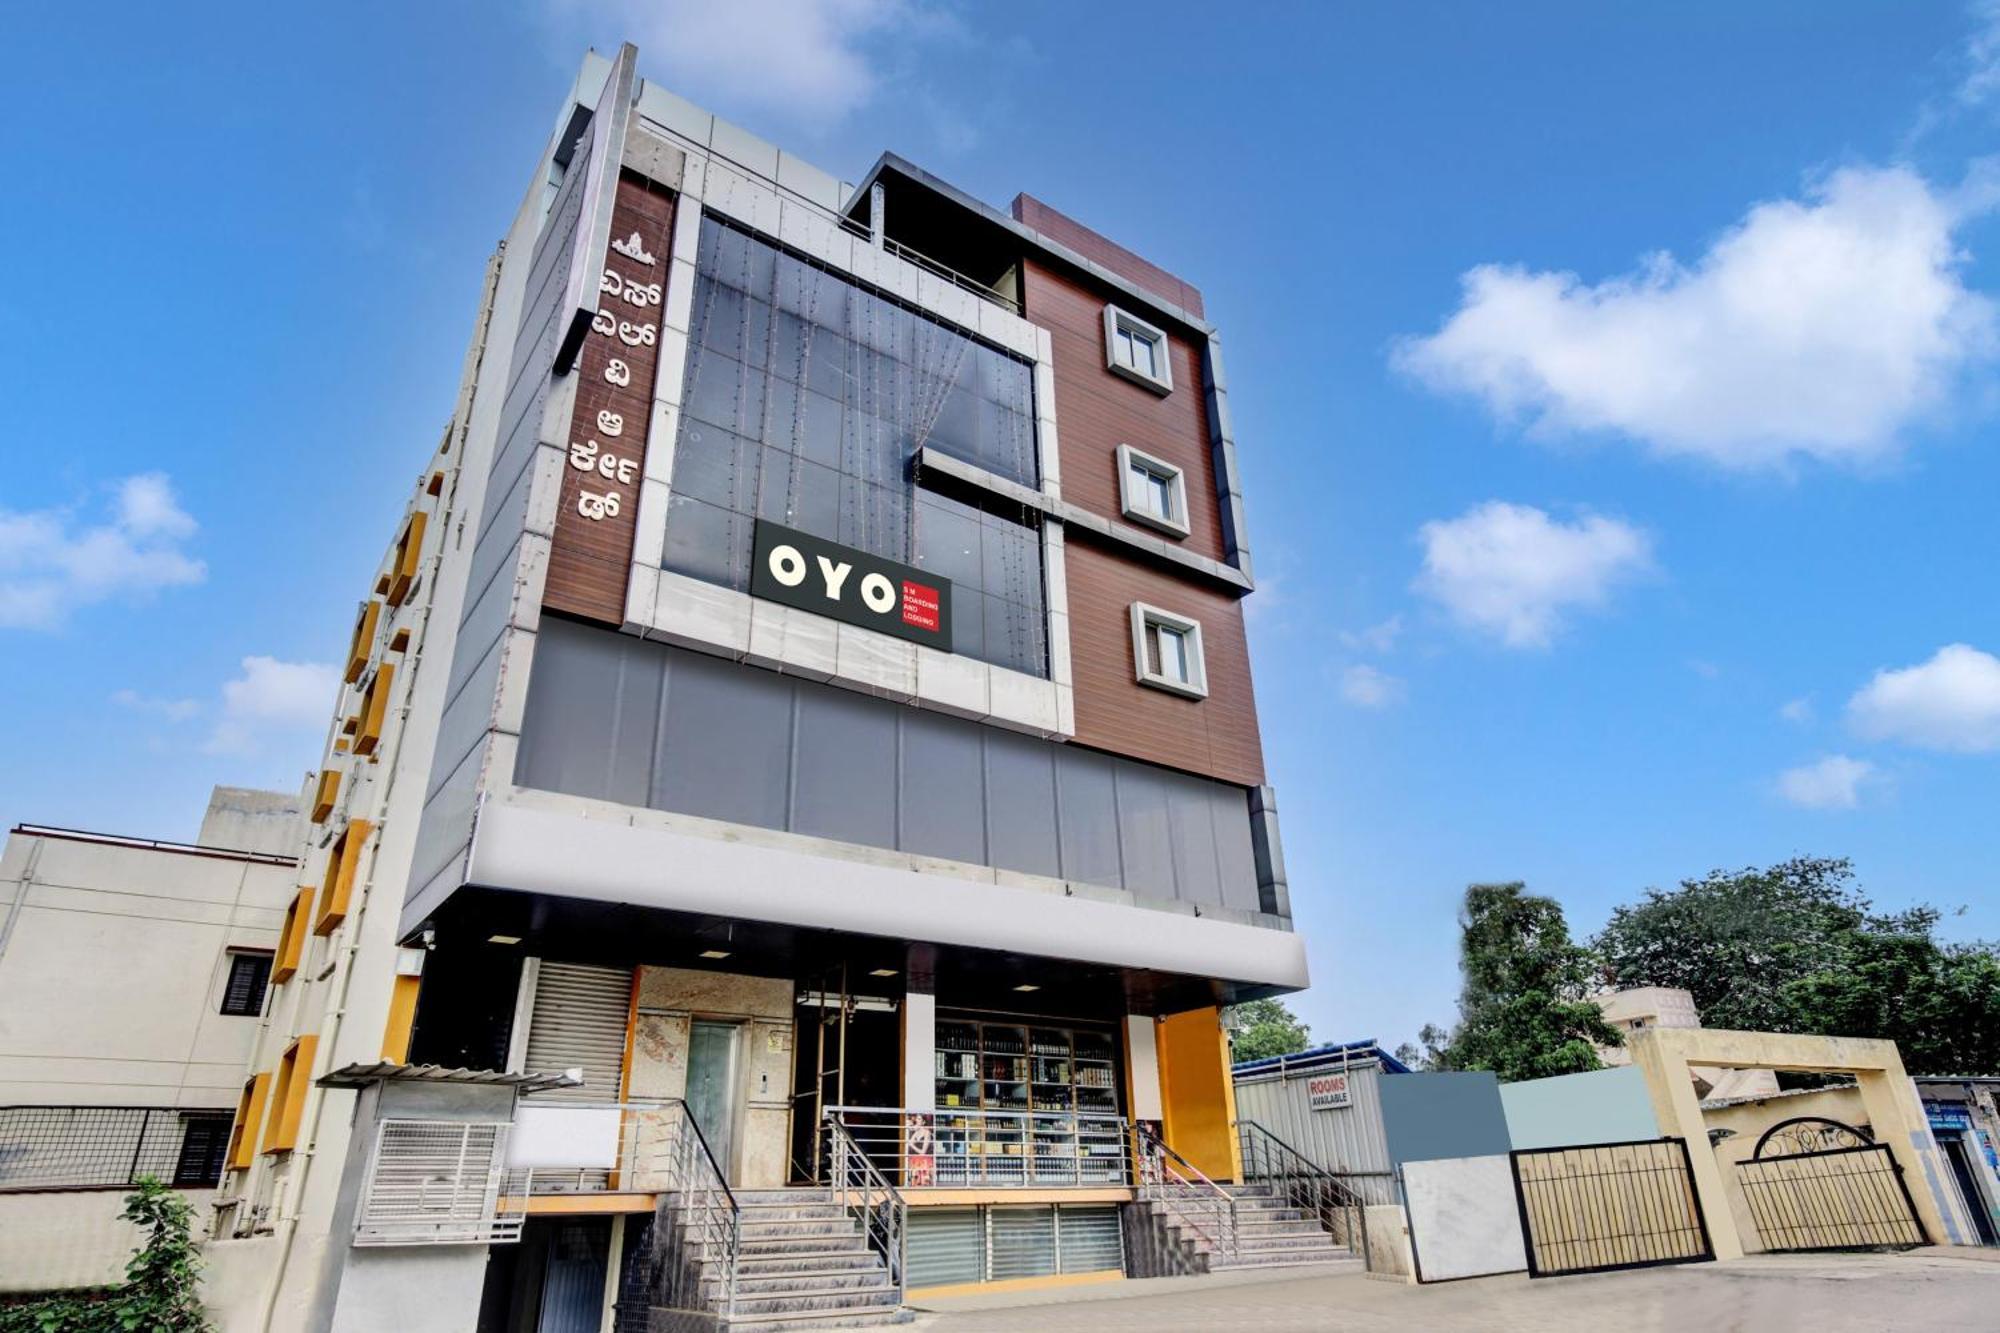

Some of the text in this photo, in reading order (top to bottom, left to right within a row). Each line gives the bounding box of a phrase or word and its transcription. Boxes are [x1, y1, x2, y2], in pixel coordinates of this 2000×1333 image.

[768, 544, 896, 614] OYO
[903, 594, 939, 611] BOARDING
[903, 603, 918, 613] AND
[1310, 1077, 1345, 1095] ROOMS
[1312, 1092, 1347, 1106] AVAILABLE
